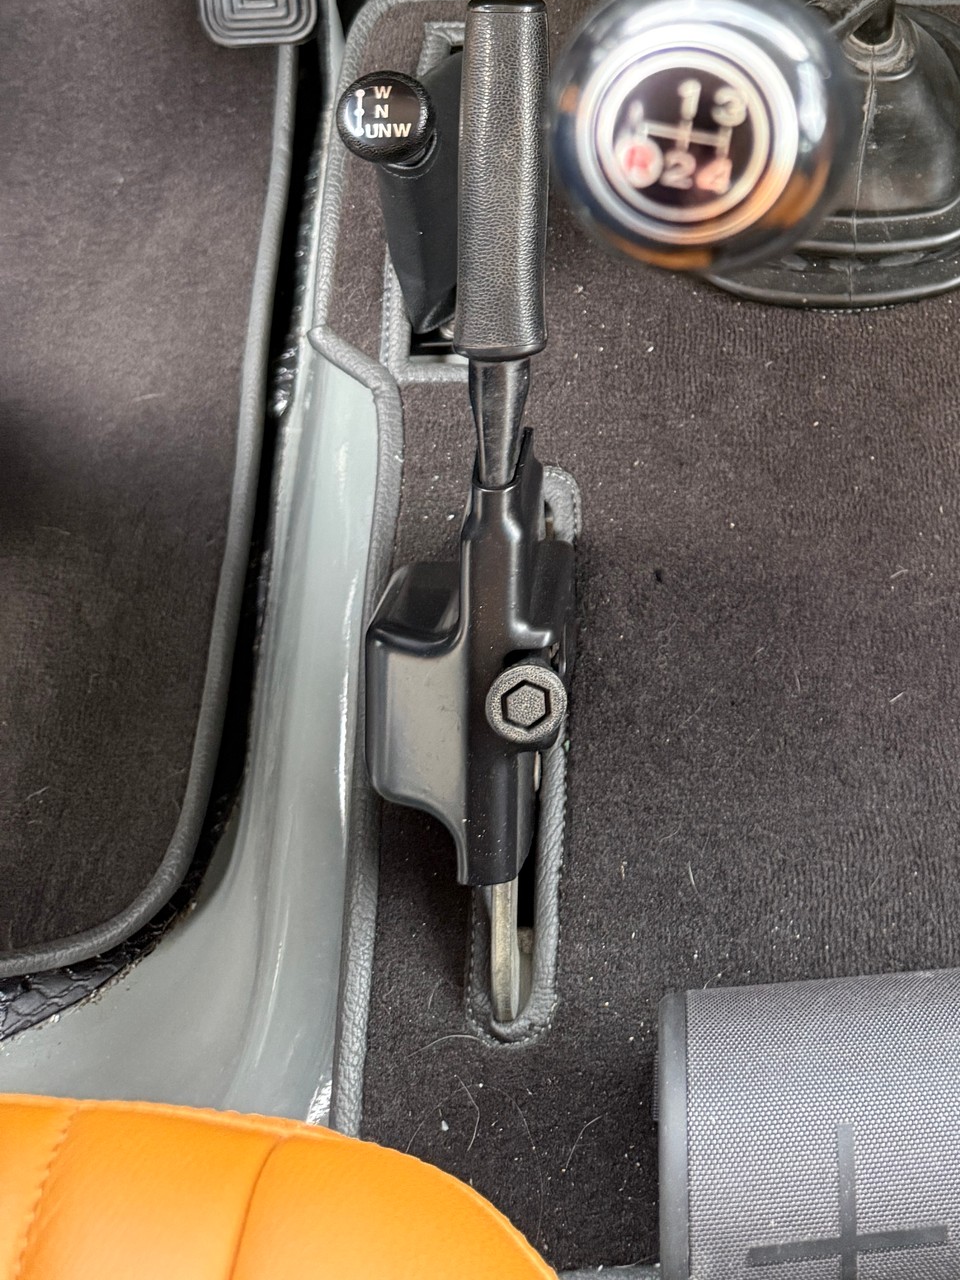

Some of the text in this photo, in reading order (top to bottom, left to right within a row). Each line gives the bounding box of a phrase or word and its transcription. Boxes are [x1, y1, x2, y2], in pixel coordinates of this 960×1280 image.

[374, 85, 393, 100] W
[374, 104, 389, 119] N
[711, 86, 747, 127] 3
[660, 150, 697, 190] 2
